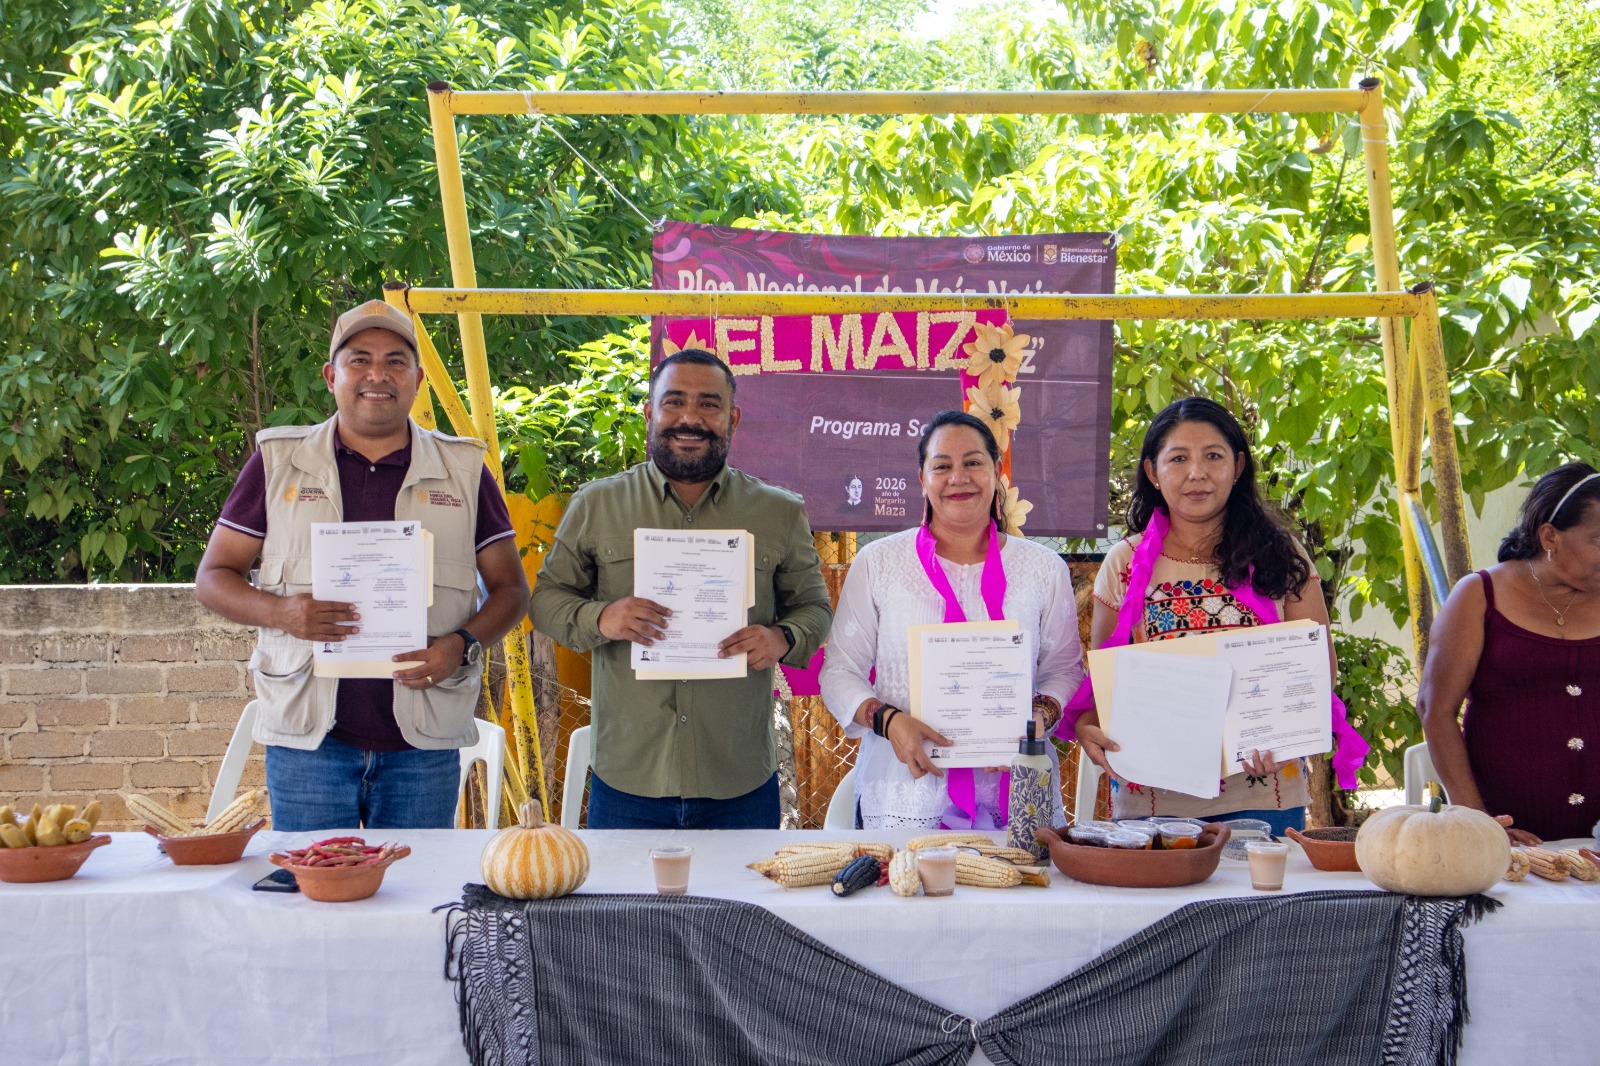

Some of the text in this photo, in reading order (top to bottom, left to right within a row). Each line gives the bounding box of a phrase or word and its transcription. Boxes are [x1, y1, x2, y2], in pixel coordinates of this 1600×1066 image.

[987, 250, 1031, 262] México
[1060, 253, 1109, 264] Bienestar
[714, 311, 977, 375] EL MAIZ
[810, 415, 901, 440] Programa
[875, 477, 907, 490] 2026
[875, 496, 906, 505] Margarita
[874, 504, 906, 516] Maza
